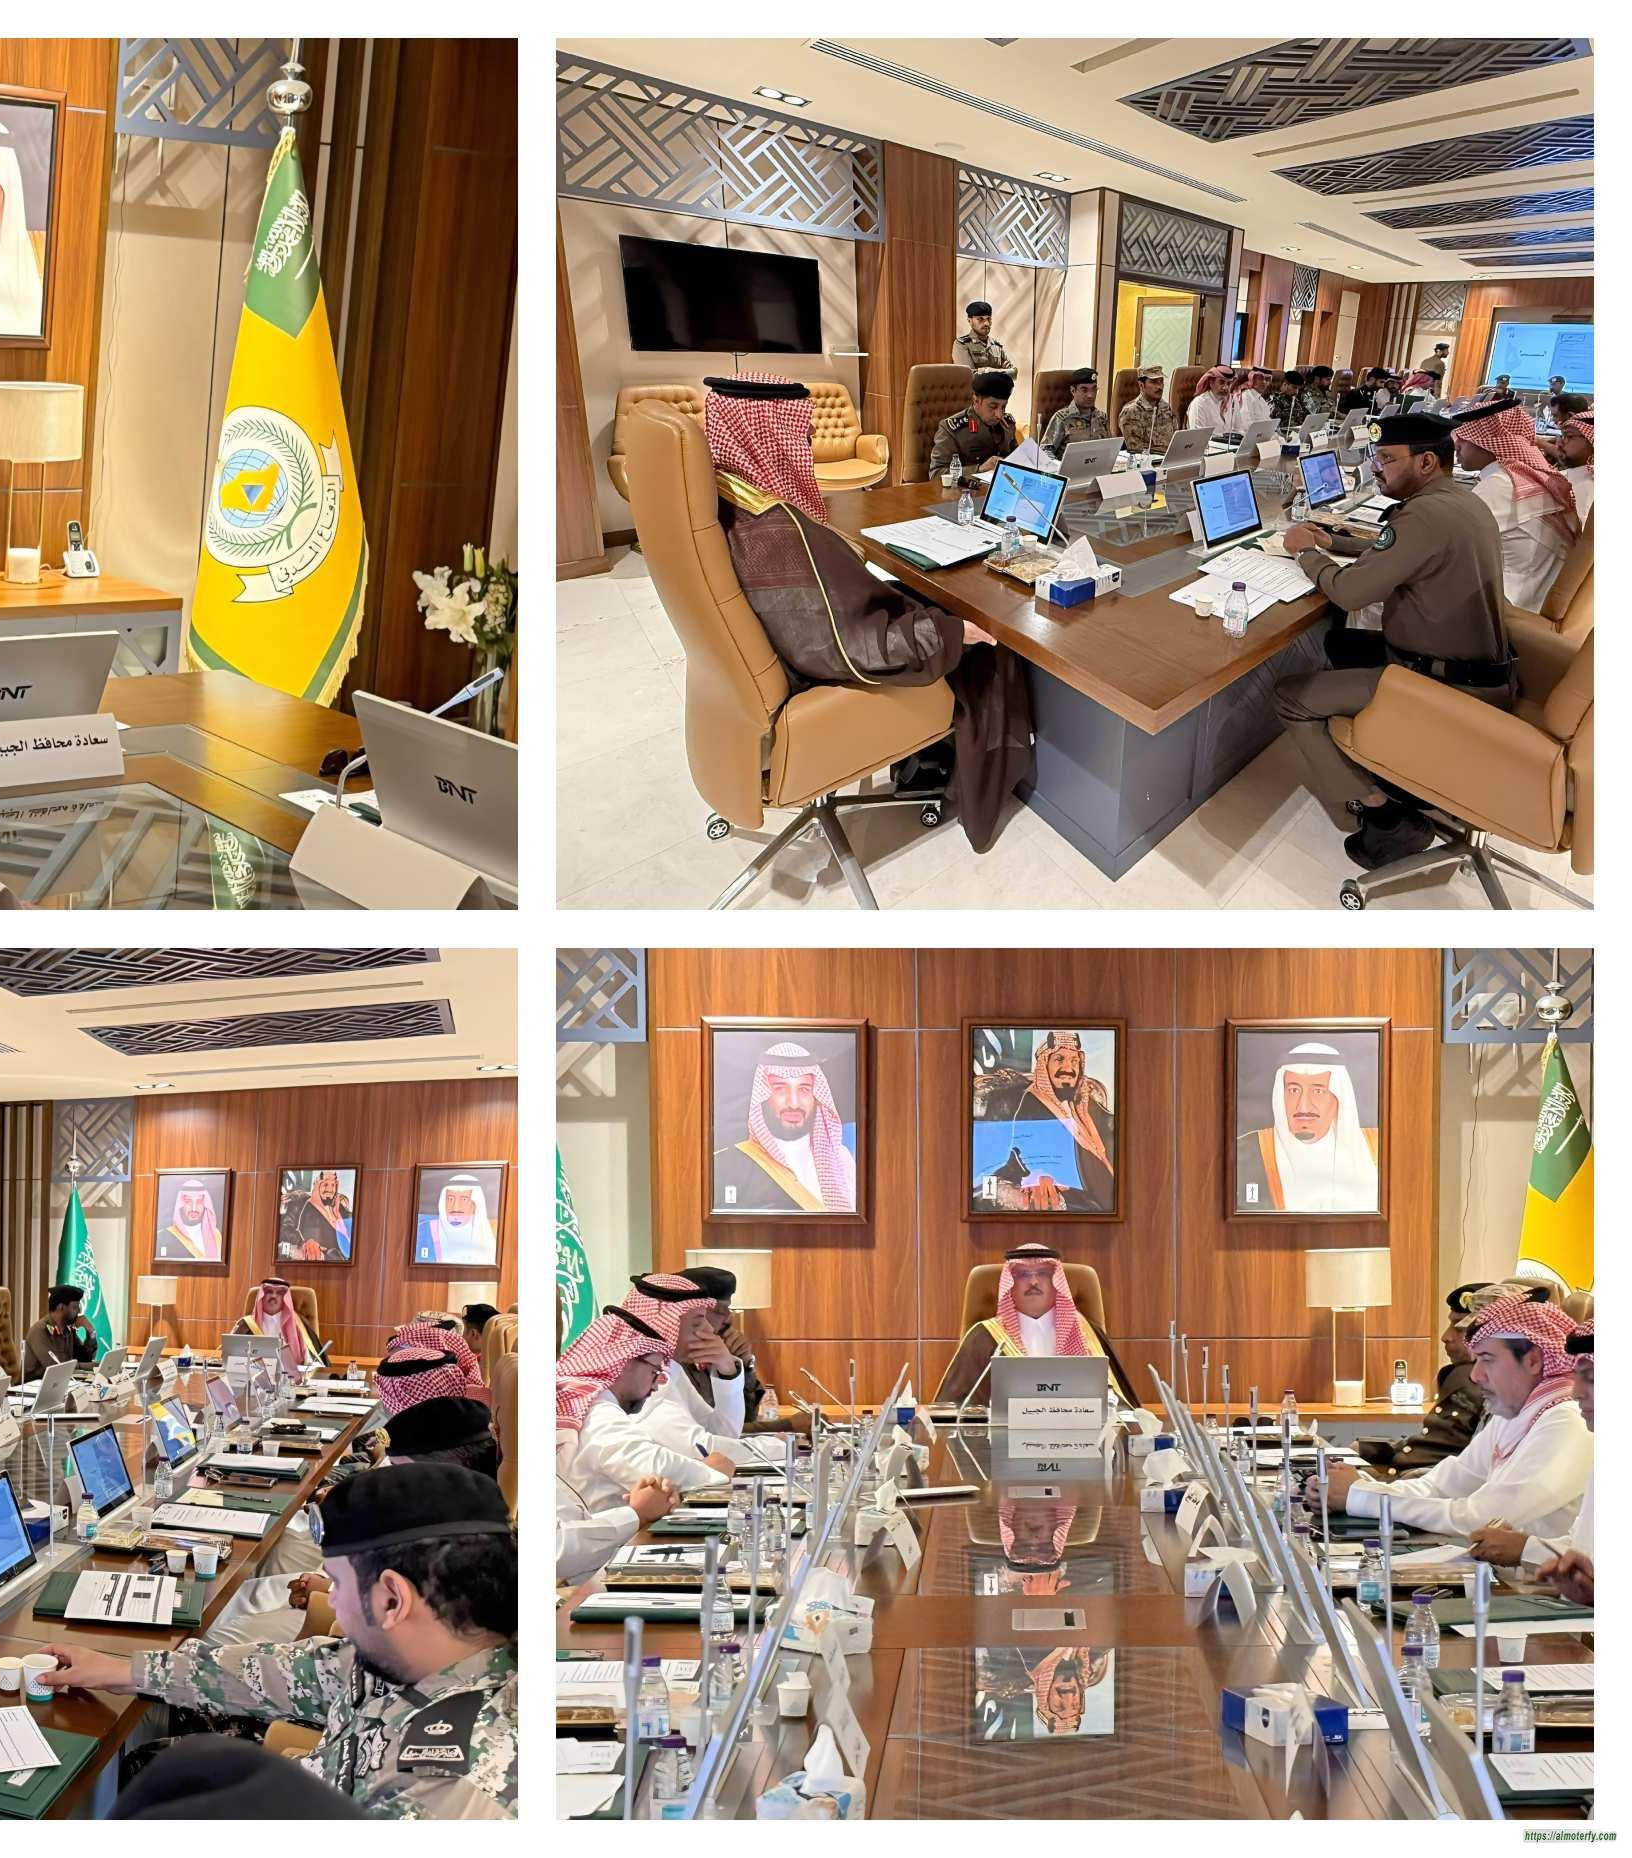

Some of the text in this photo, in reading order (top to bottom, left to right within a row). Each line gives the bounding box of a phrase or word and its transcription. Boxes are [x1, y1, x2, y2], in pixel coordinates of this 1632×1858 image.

[32, 735, 72, 751] محافظ
[75, 733, 109, 747] سعادة
[434, 775, 478, 805] BNT
[1036, 1383, 1062, 1392] BNT
